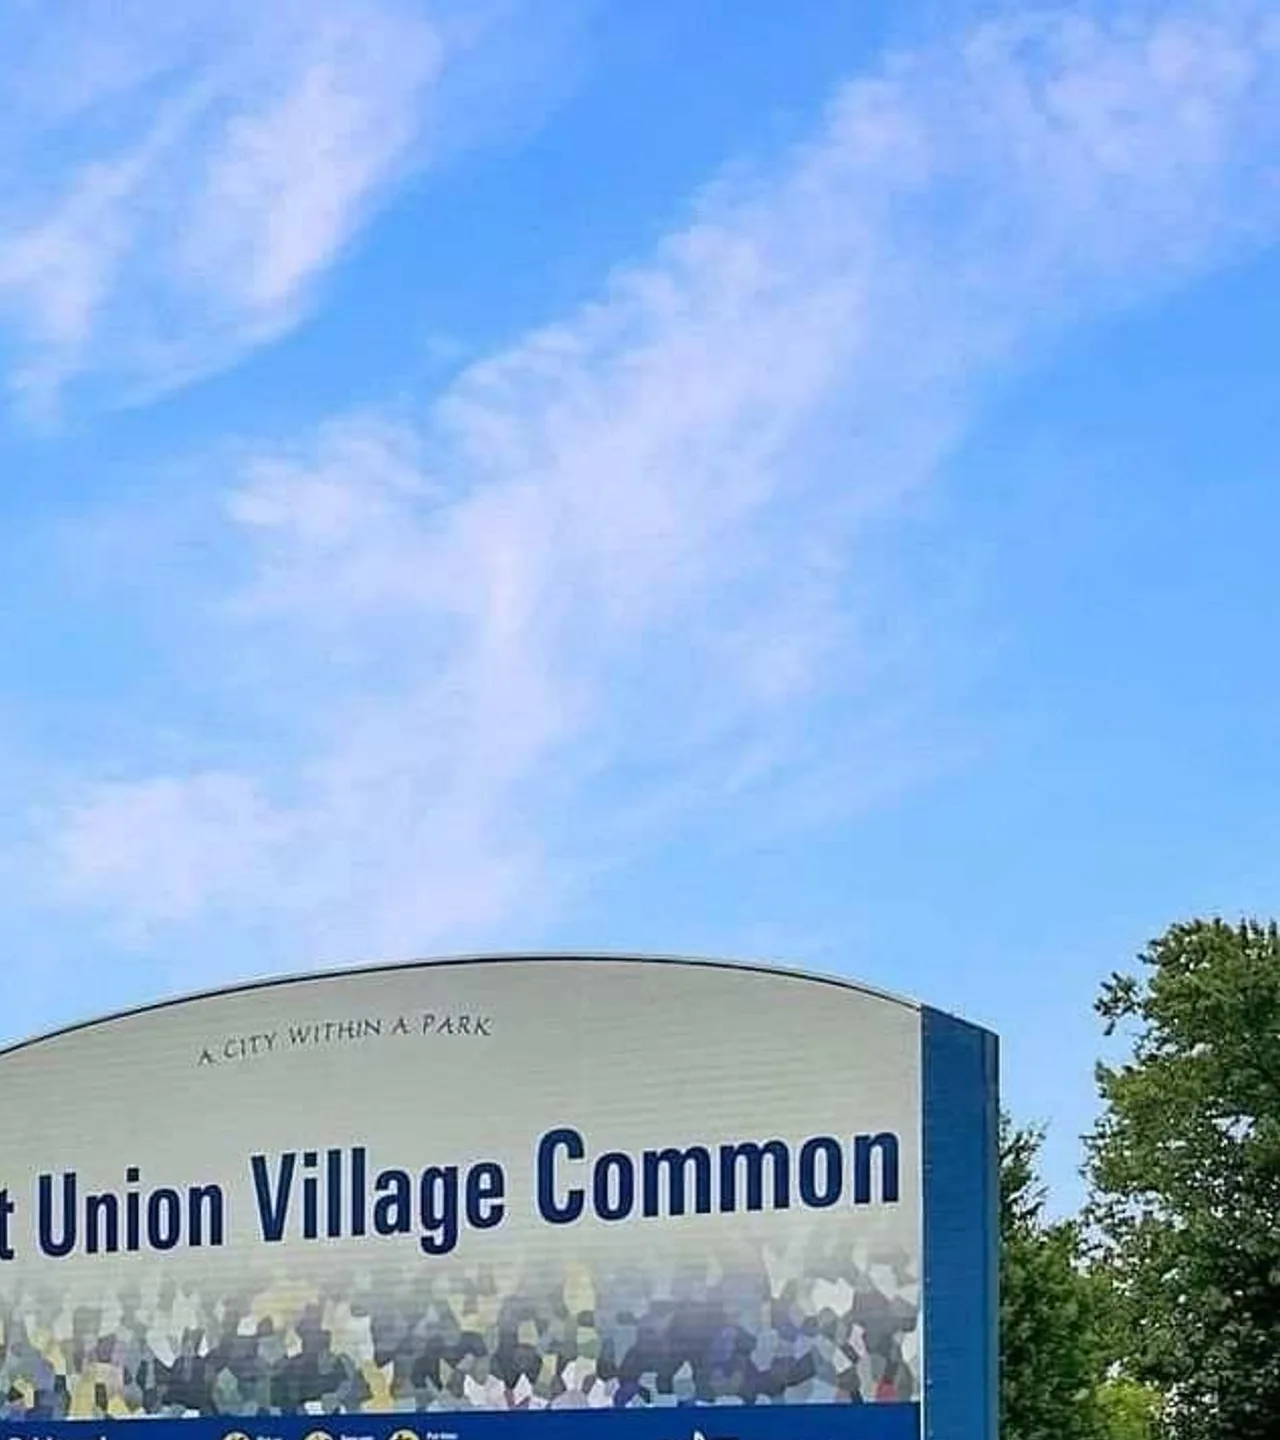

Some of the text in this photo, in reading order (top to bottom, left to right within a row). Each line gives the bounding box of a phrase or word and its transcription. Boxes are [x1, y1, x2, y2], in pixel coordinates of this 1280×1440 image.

[197, 1013, 491, 1067] A CITY WITHIN A PARK
[38, 1167, 224, 1258] Union
[251, 1146, 506, 1256] Village
[536, 1128, 900, 1225] Common
